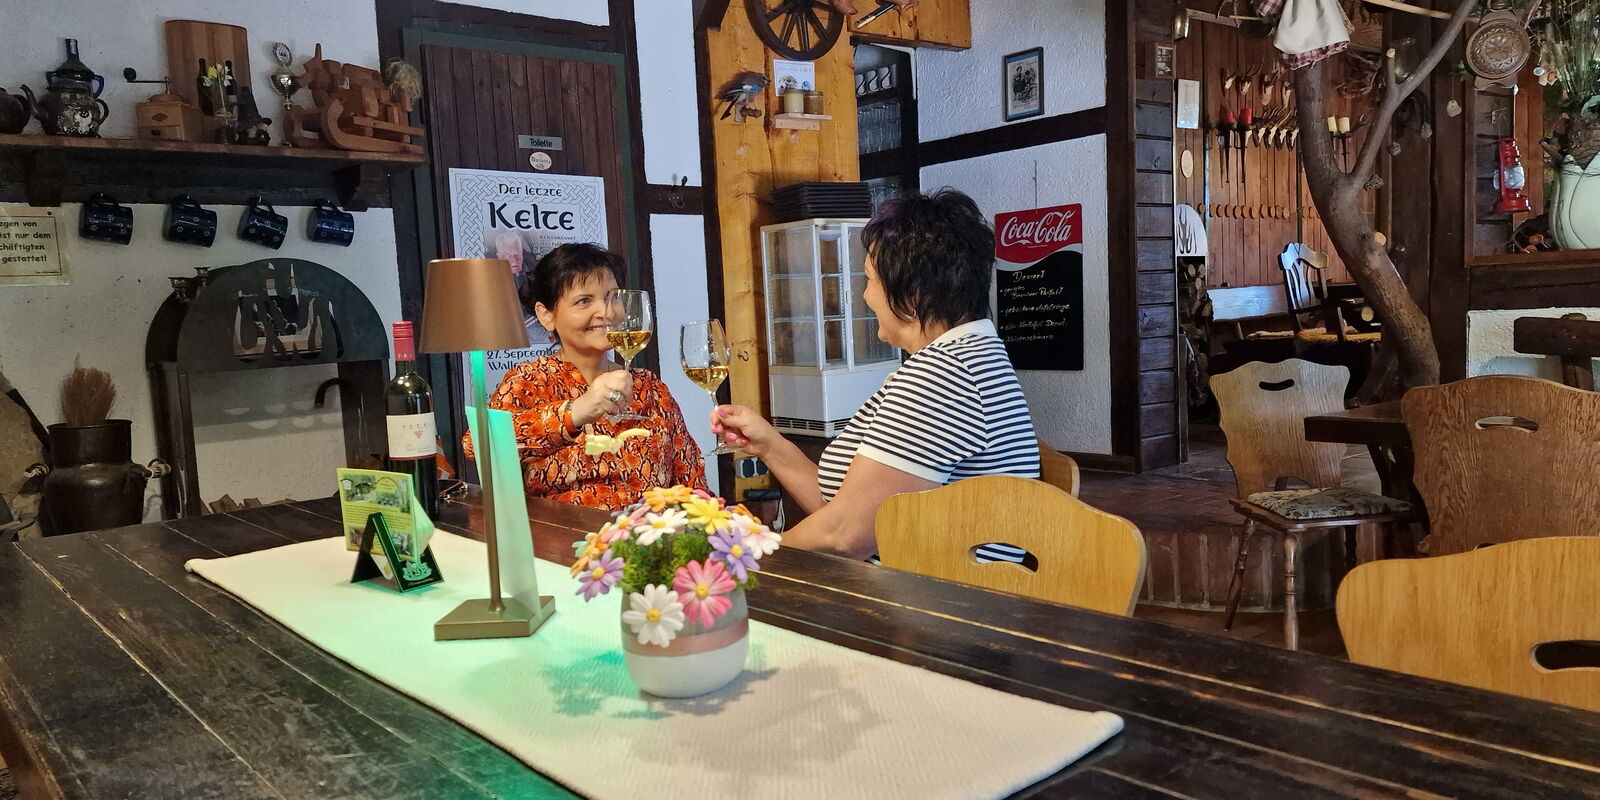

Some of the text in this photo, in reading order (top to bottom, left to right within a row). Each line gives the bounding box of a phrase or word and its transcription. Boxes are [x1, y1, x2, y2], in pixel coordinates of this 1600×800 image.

[530, 139, 553, 148] Toilette
[499, 183, 562, 196] Der letzte
[487, 202, 575, 230] Kelte
[1000, 210, 1076, 247] Coca-Cola
[33, 231, 52, 239] dem
[2, 254, 47, 264] gestattet!
[486, 347, 558, 360] 27. Septembe
[488, 360, 519, 371] Walle
